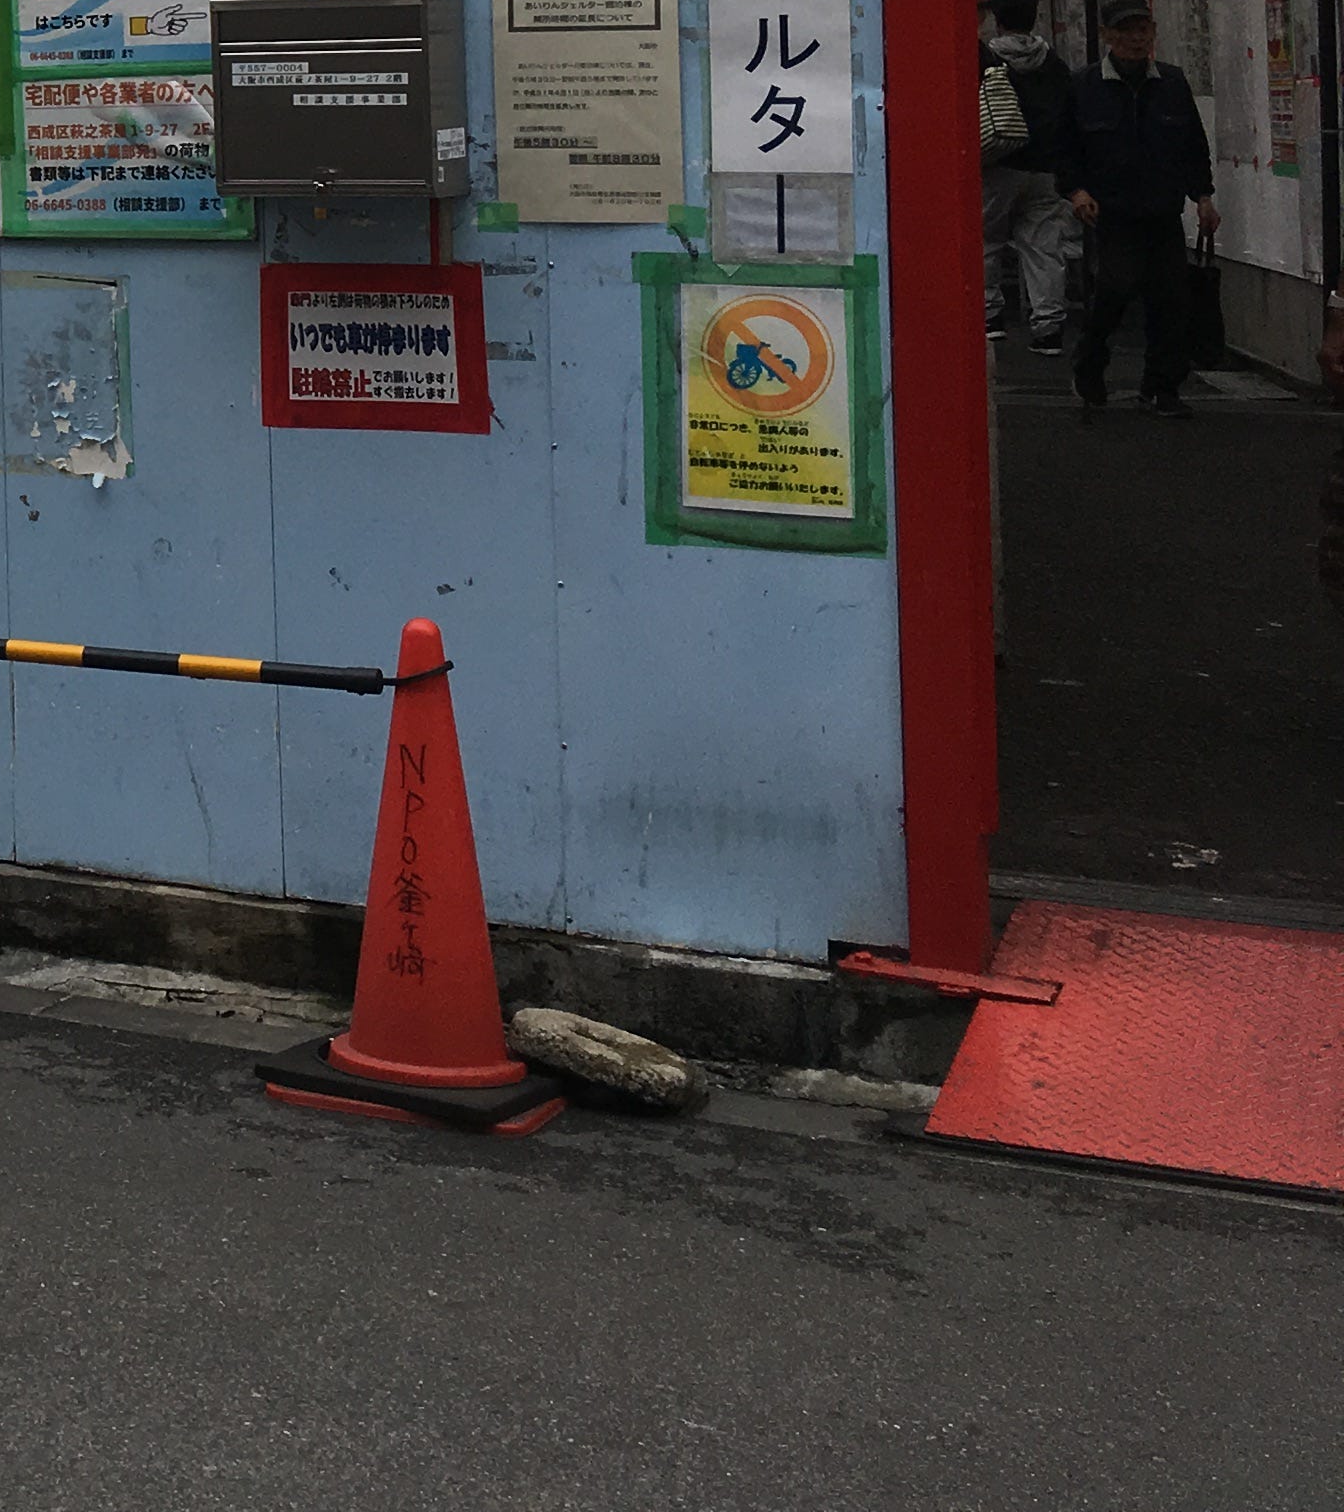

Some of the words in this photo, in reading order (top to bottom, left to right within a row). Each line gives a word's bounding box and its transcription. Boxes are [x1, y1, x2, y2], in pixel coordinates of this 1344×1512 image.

[35, 14, 113, 30] はこちらです
[24, 80, 215, 107] 宅配便や各業者の方へ
[131, 125, 178, 138] 1-9-27
[192, 123, 212, 137] 2F
[165, 143, 211, 159] の荷物
[24, 196, 107, 212] 06-6645-0388
[199, 197, 222, 211] まで
[290, 322, 452, 357] いつでも車が停まります
[291, 367, 373, 399] 駐輪禁止
[372, 370, 454, 384] でお願いします！
